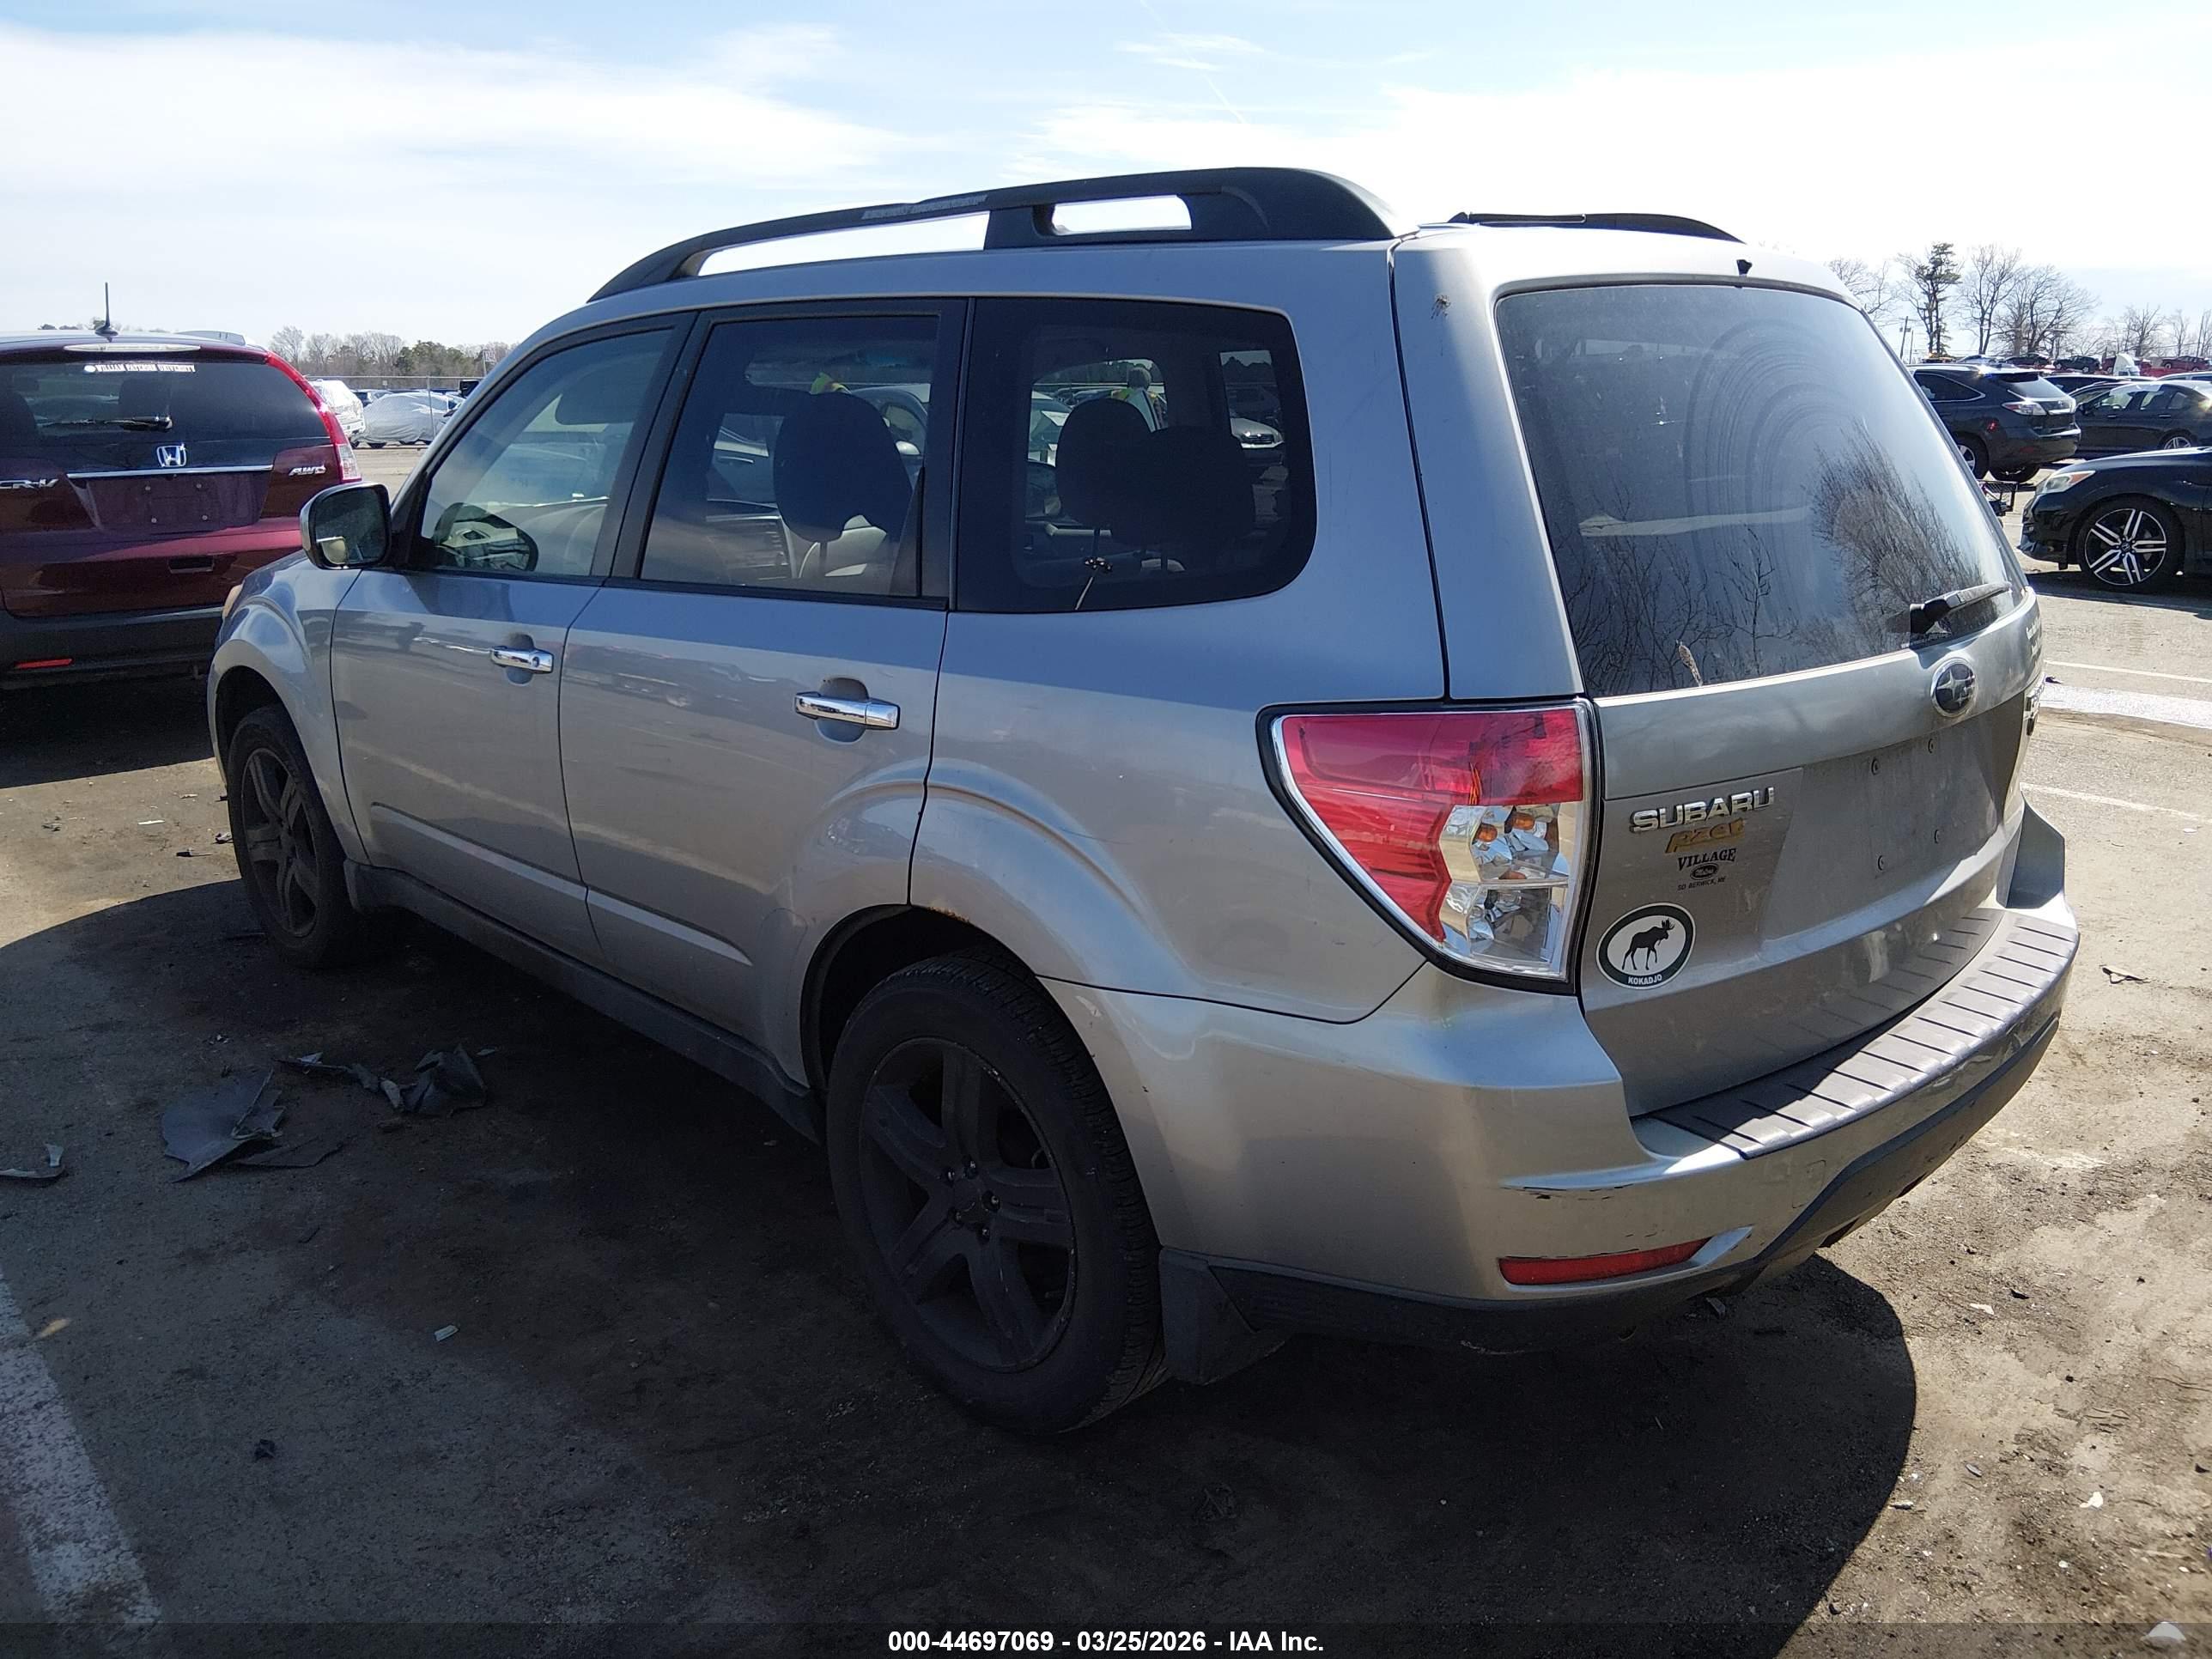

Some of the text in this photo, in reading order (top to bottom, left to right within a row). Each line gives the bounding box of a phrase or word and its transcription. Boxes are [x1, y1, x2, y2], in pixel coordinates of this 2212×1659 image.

[289, 465, 326, 476] AWD
[1631, 787, 1775, 833] SUBARU
[1678, 848, 1736, 872] VILLAGE
[1627, 974, 1662, 985] KOKADJO
